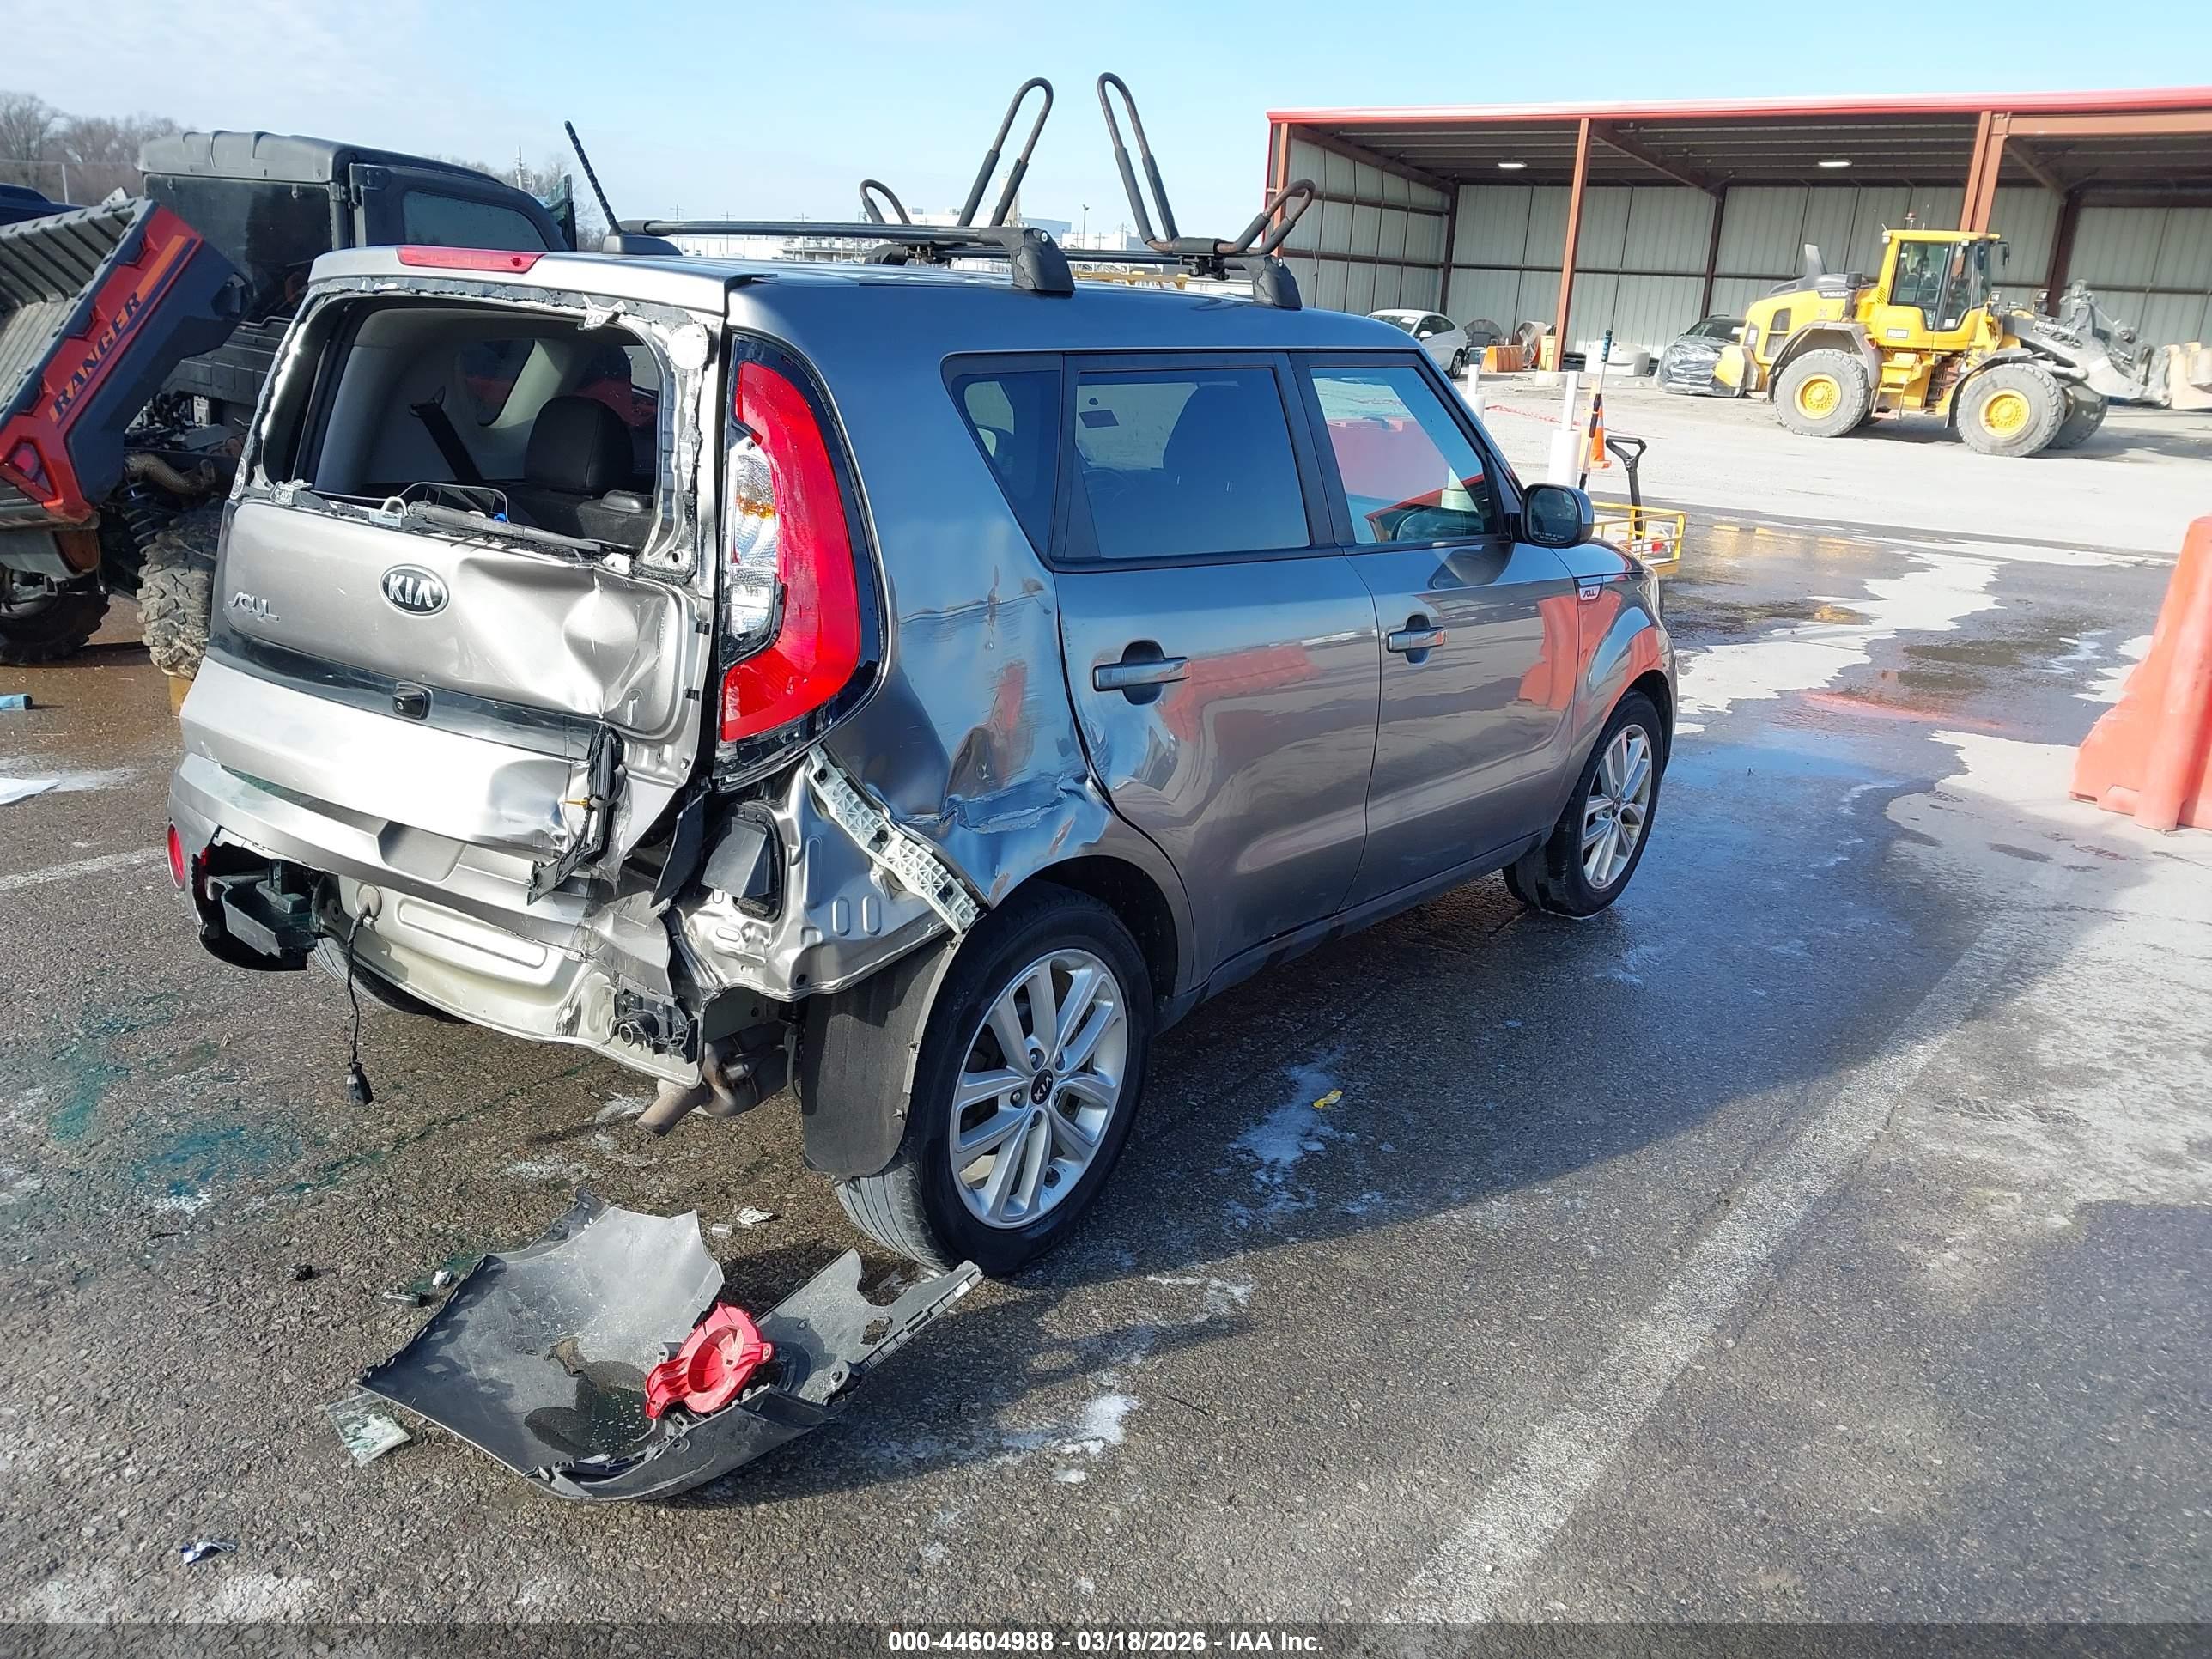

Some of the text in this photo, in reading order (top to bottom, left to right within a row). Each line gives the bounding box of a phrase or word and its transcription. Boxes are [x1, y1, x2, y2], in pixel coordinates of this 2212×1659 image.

[51, 292, 142, 419] RANGER
[389, 574, 434, 608] KIA
[1035, 1077, 1052, 1101] KIA
